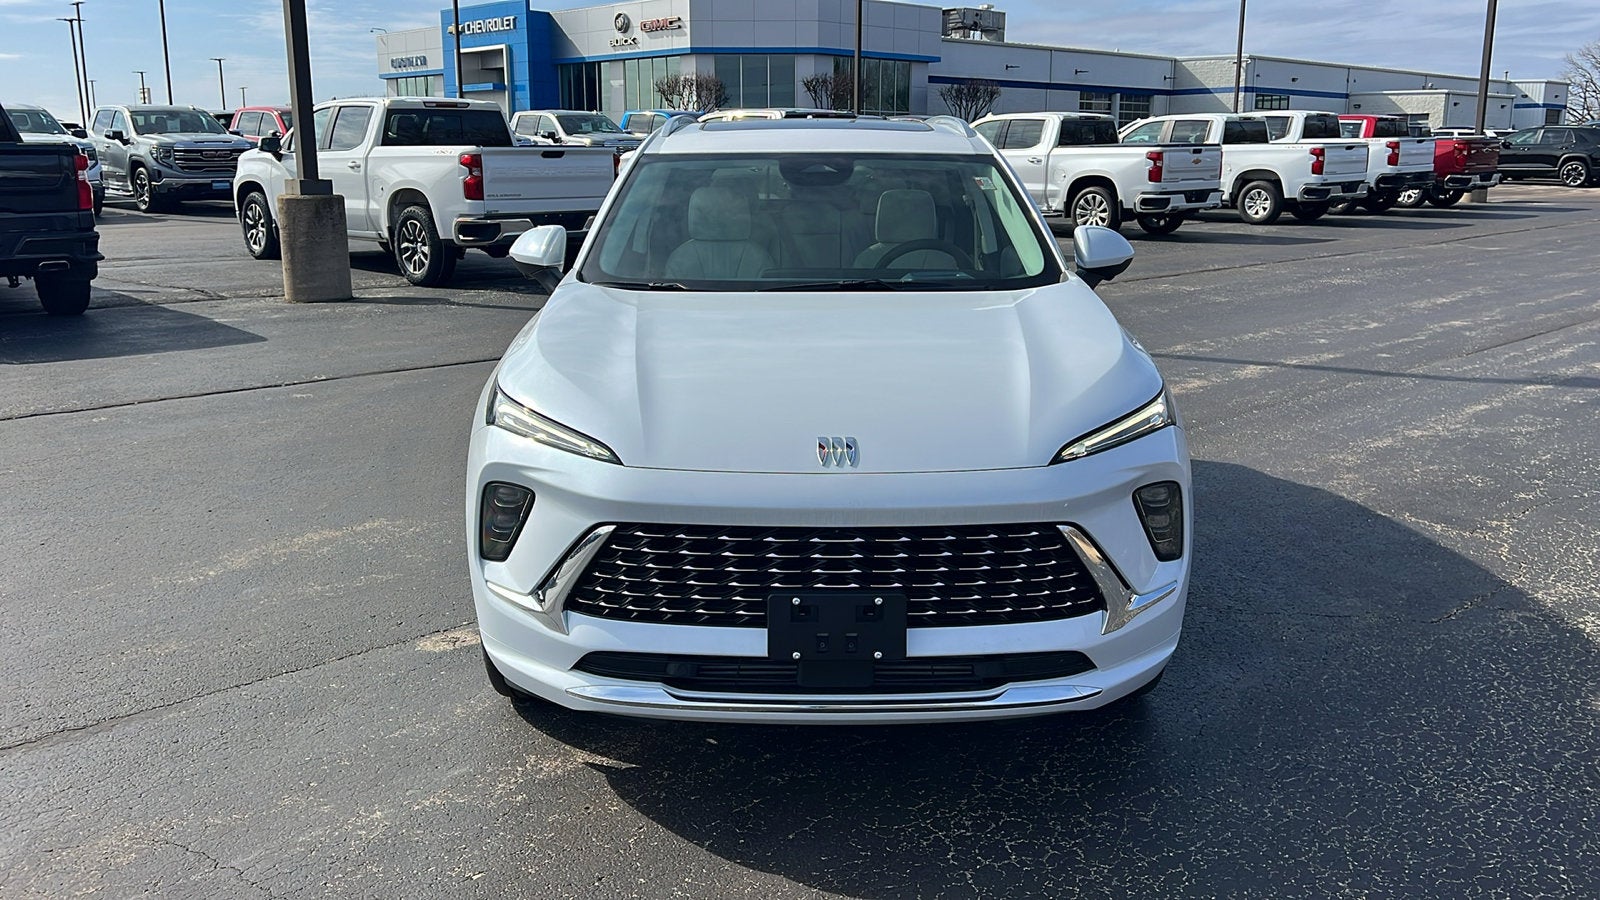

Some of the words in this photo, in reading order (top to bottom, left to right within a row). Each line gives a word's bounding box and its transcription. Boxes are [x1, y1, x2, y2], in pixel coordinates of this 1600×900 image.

[464, 16, 516, 34] CHEVROLET
[640, 16, 682, 32] GMC
[609, 37, 637, 47] BUICK
